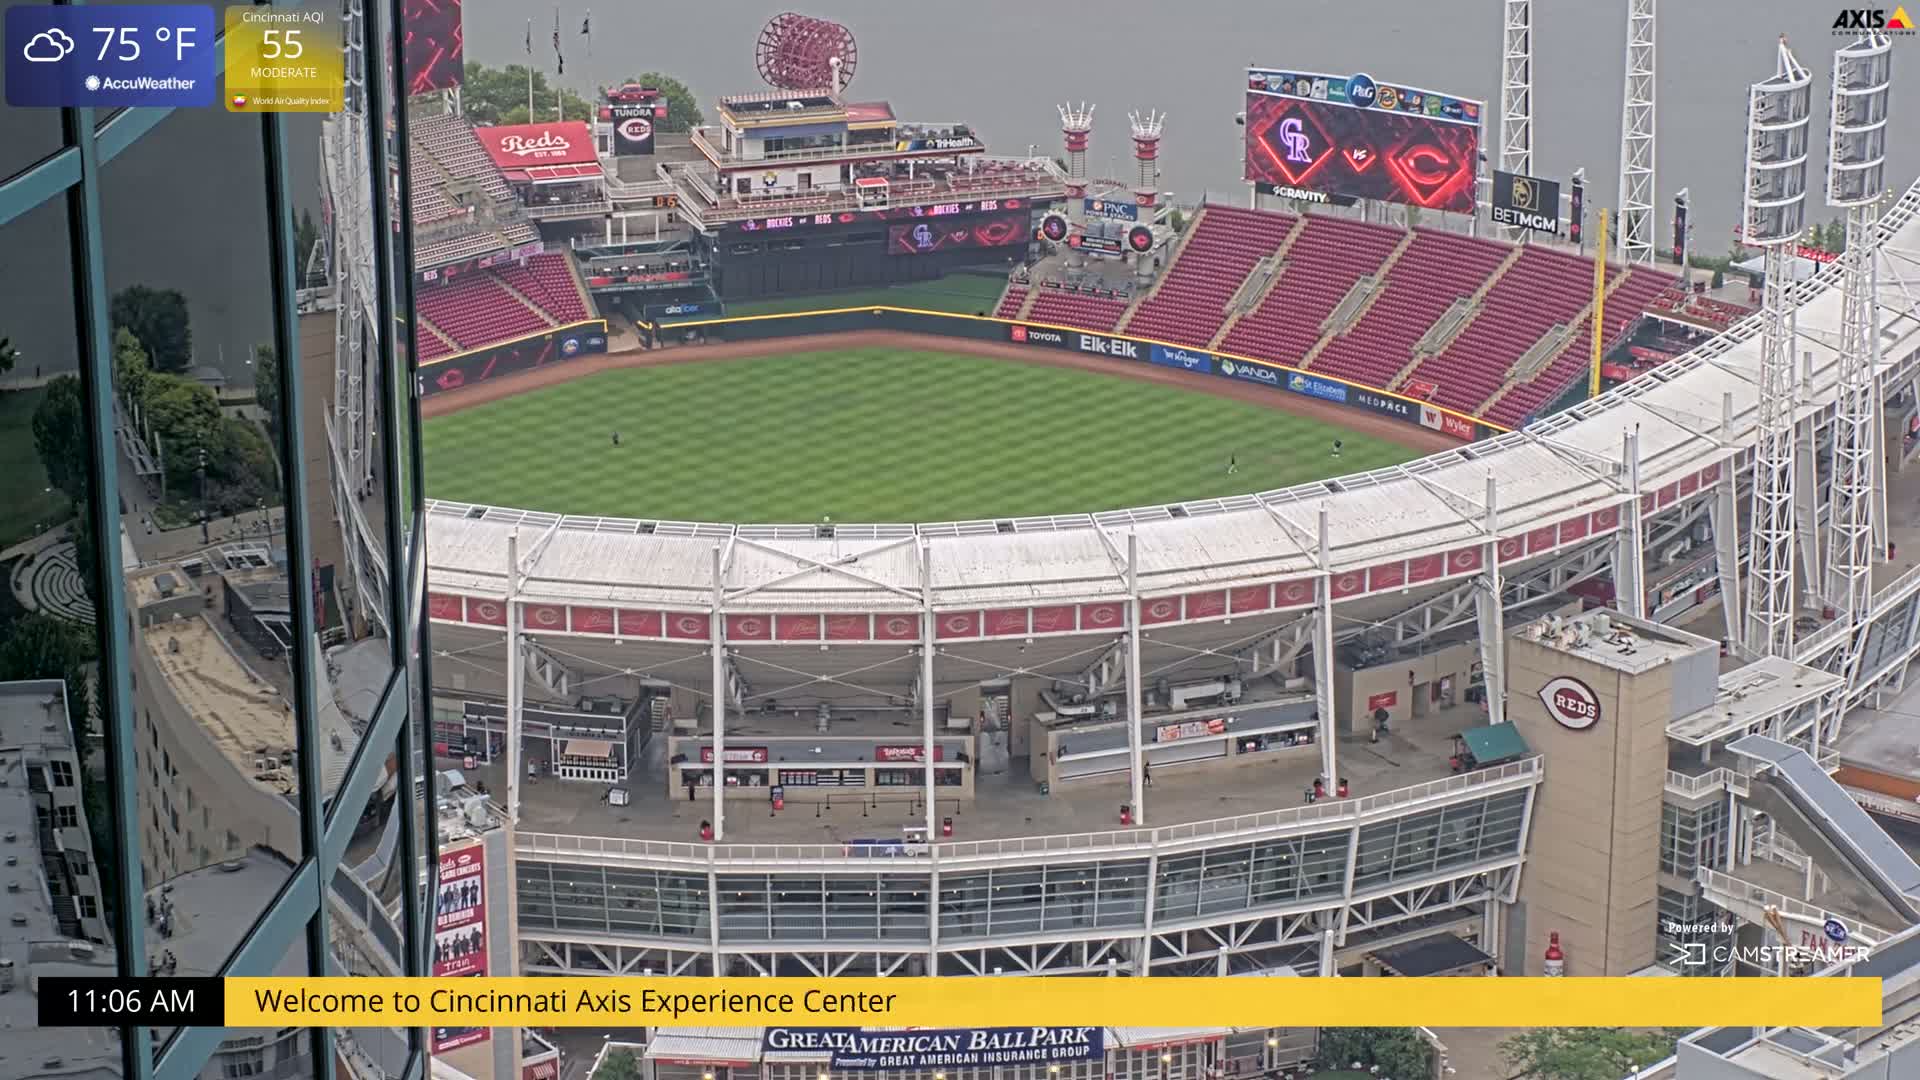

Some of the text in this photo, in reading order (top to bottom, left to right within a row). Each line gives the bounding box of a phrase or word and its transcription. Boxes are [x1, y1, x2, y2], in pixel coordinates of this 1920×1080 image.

[1352, 85, 1374, 98] P&G
[615, 108, 652, 117] TUNDRA
[501, 131, 570, 155] Reds
[935, 137, 974, 149] TriHealth
[1103, 202, 1129, 215] PNC
[1493, 206, 1556, 232] BETMGM
[1028, 331, 1062, 343] TOYOTA
[1234, 363, 1278, 382] VANDA
[1358, 394, 1408, 415] MEDPACE
[1445, 416, 1472, 434] Wyler
[1556, 694, 1596, 717] REDS
[768, 1028, 847, 1048] GREAT
[839, 1033, 961, 1054] AMERICAN
[835, 1045, 1090, 1069] Presented by GREAT AMERICAN INSURANCE GROUP
